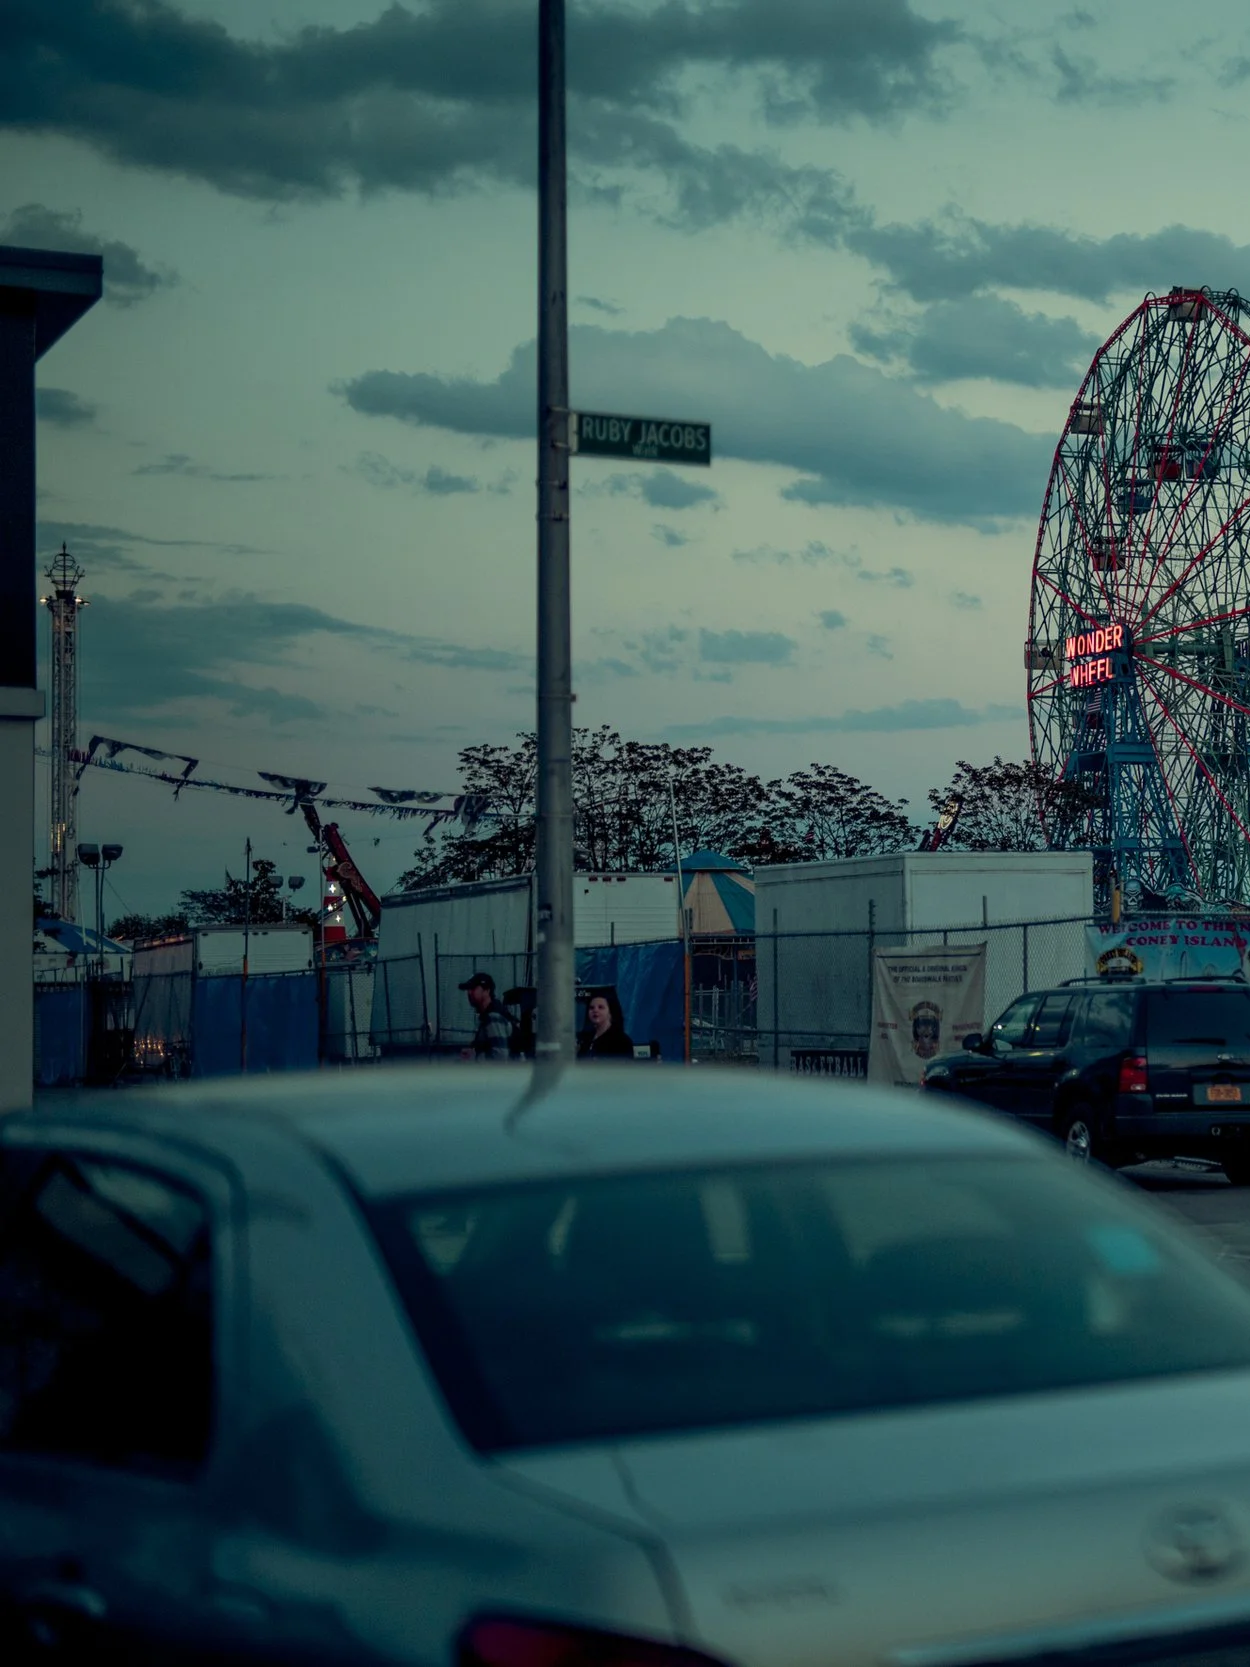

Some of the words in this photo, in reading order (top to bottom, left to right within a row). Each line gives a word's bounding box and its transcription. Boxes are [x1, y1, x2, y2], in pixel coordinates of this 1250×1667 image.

[582, 416, 632, 443] RUBY
[638, 423, 707, 450] JACOBS
[1066, 624, 1123, 660] WONDER
[1071, 657, 1114, 687] WHEEL
[1100, 920, 1170, 935] WECOME
[1176, 920, 1198, 931] TO
[1202, 920, 1236, 932] THE
[1126, 935, 1178, 947] CONEY
[1185, 935, 1248, 948] ISLAND
